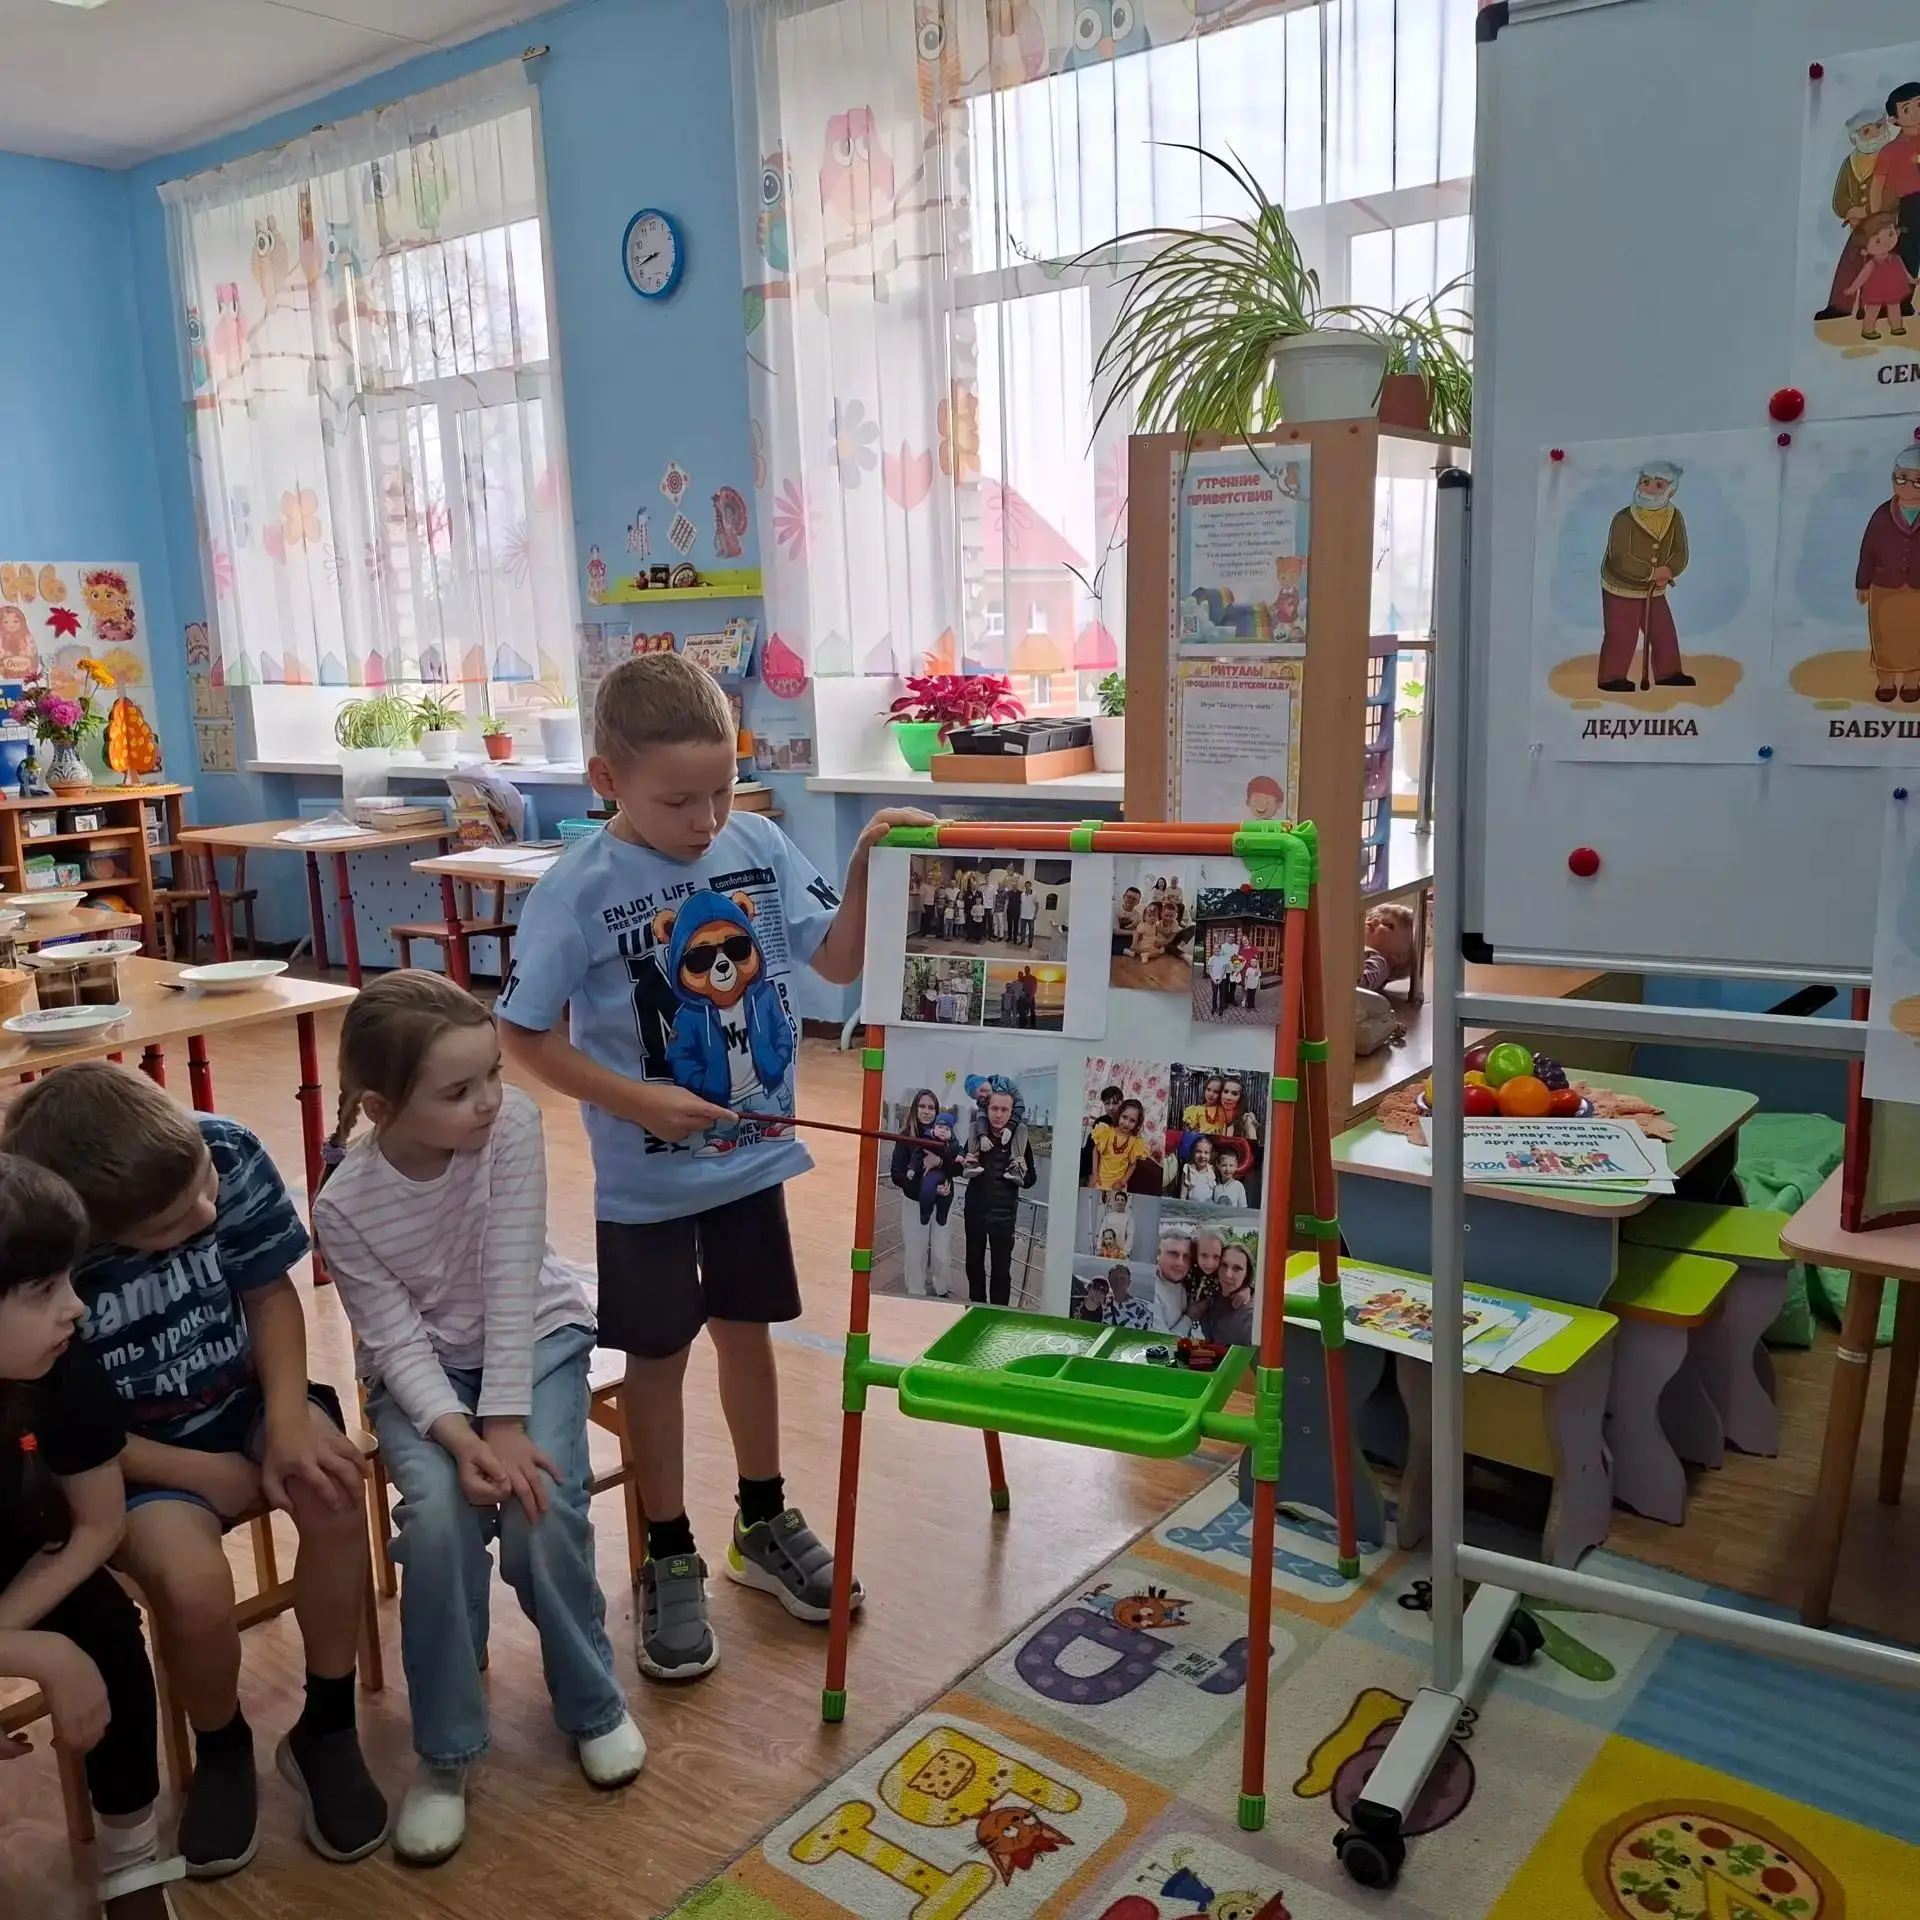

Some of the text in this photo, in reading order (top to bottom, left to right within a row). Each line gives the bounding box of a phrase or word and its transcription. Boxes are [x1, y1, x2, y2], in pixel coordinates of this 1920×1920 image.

[1210, 665, 1263, 677] РИТУАЛЫ
[1582, 719, 1699, 738] ДЕДУШКА
[1829, 720, 1920, 738] БАБУШ
[603, 881, 697, 923] ENJOY LIFE
[607, 907, 658, 933] FREE SPIRIT
[723, 1022, 749, 1055] NY
[739, 1134, 761, 1148] GIVE
[152, 1305, 227, 1361] уроки,
